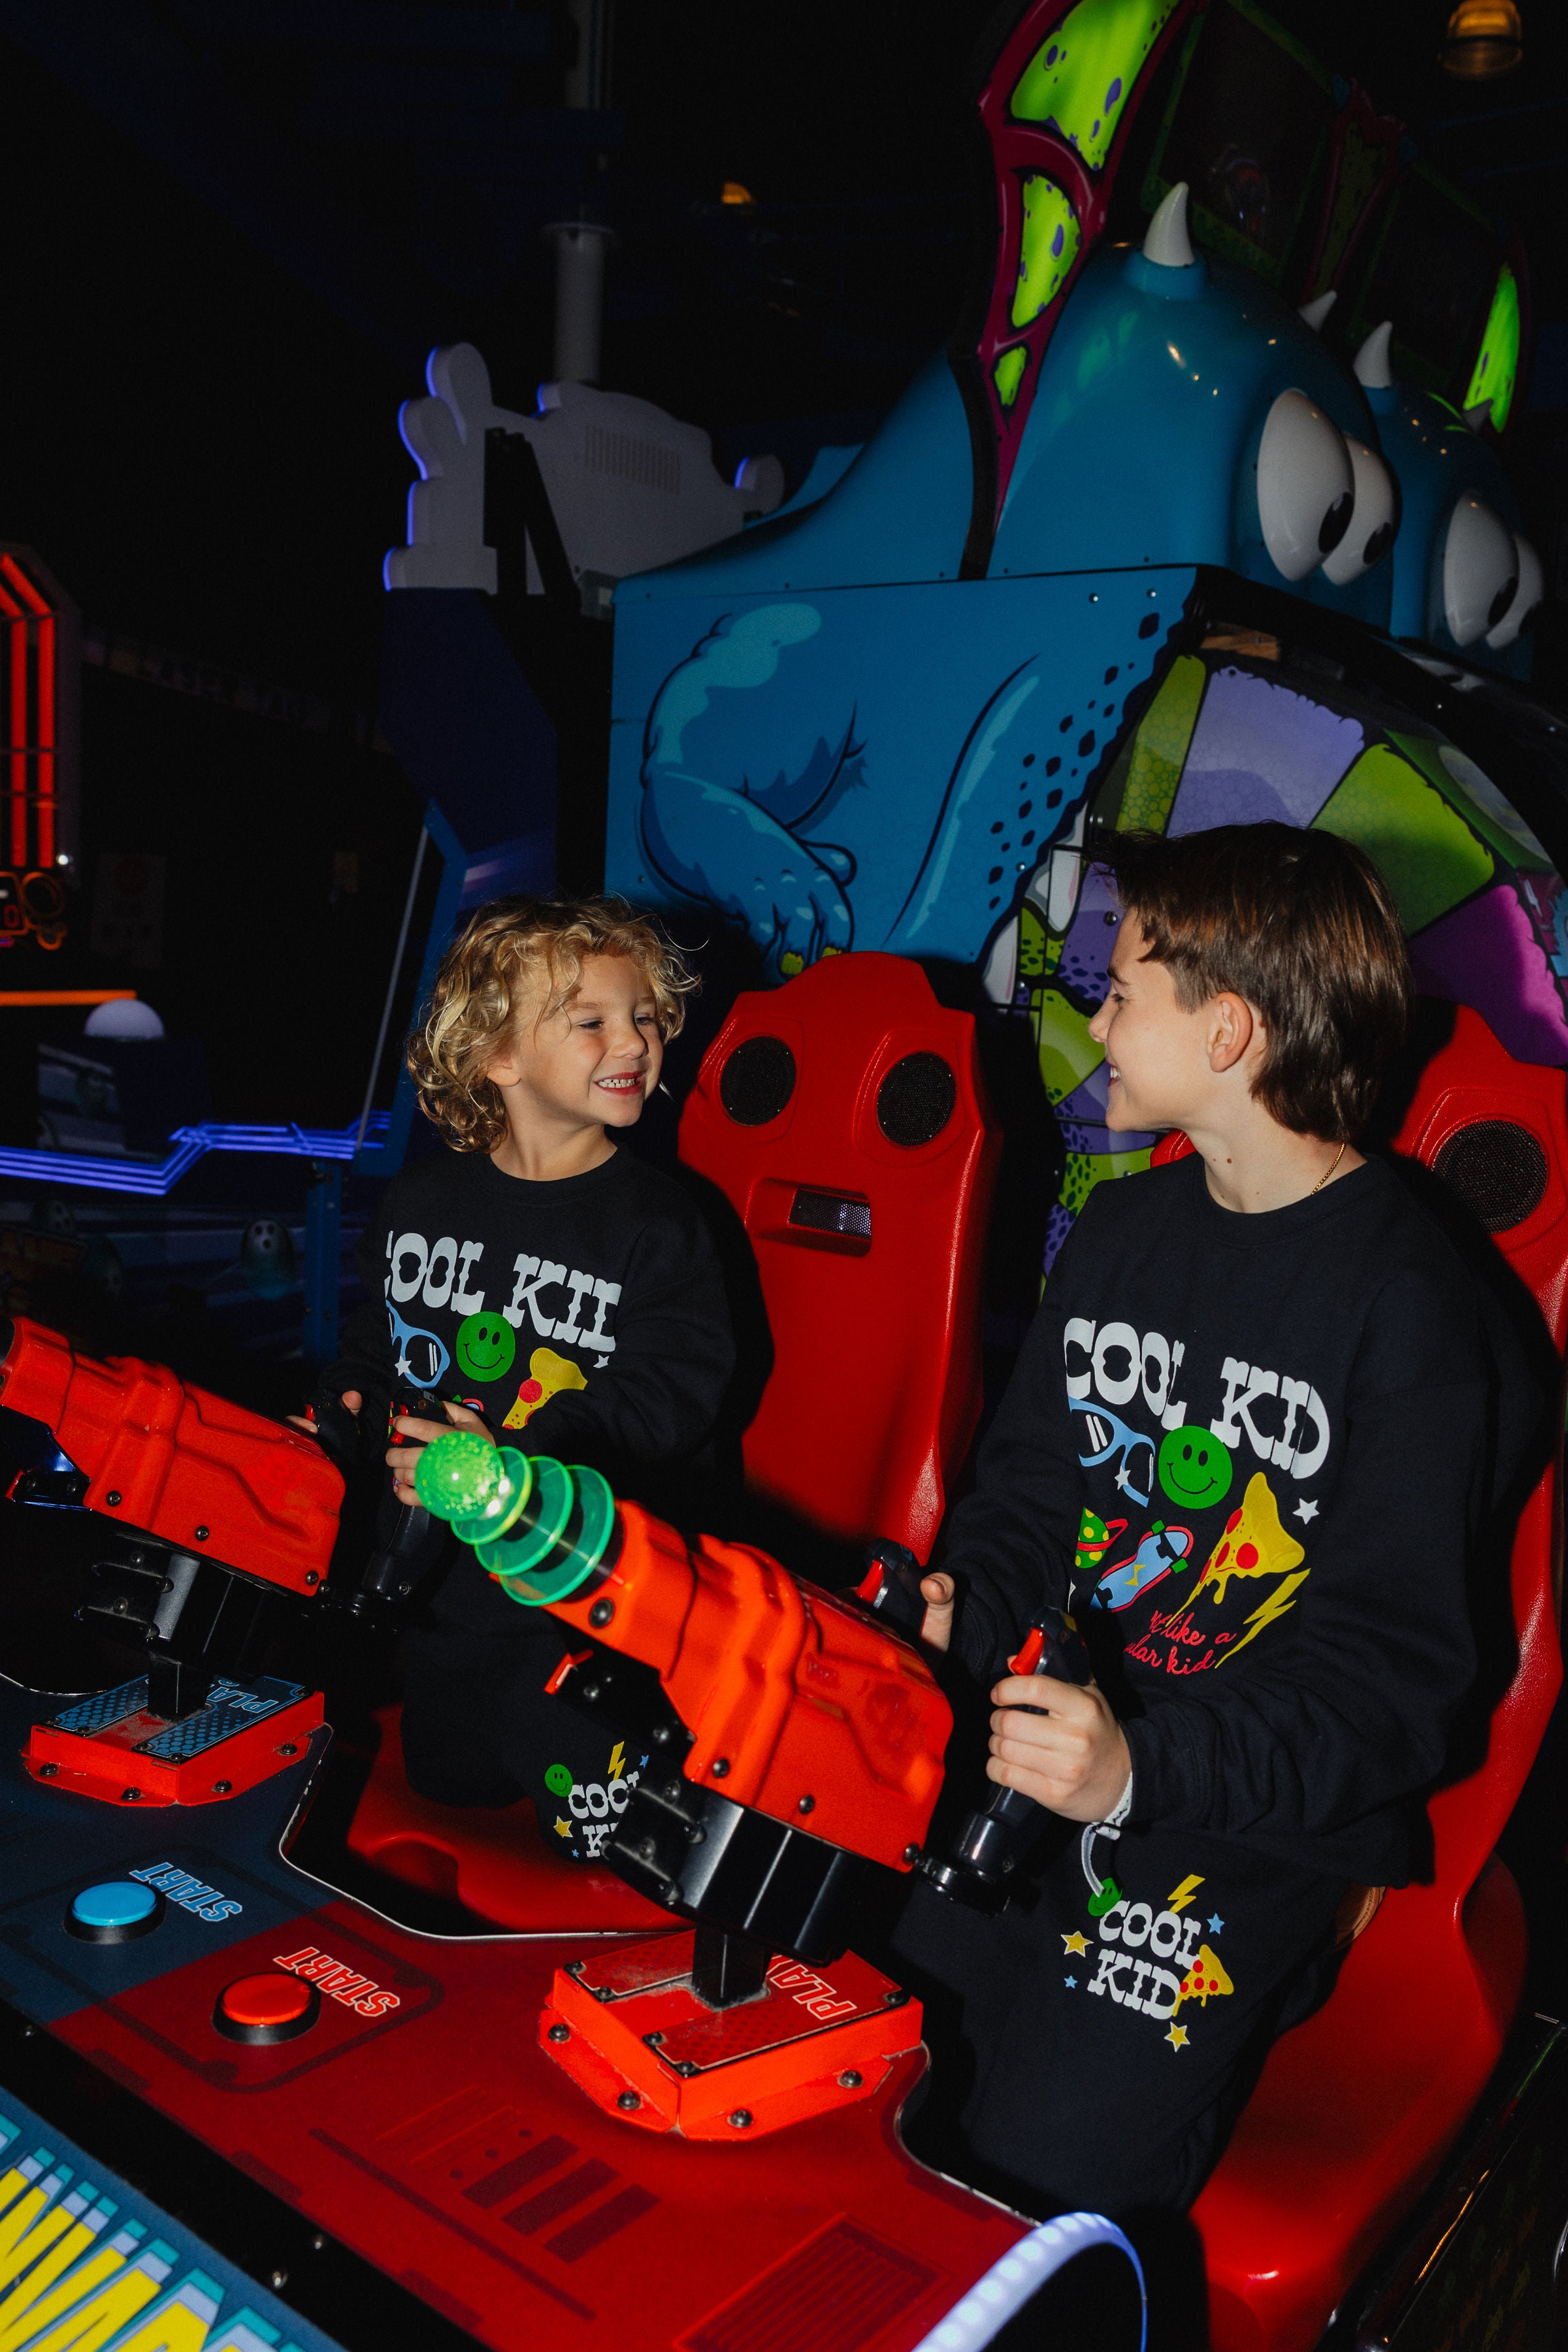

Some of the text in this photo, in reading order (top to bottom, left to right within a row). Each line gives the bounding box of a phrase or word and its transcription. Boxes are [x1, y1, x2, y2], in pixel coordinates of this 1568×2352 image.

[384, 1230, 485, 1316] OOL
[1064, 1318, 1330, 1479] COOL KID
[1166, 1646, 1216, 1675] kid
[1214, 1632, 1237, 1644] a
[568, 1771, 640, 1819] COO
[129, 1862, 242, 1922] START
[1099, 1900, 1201, 1970] COOL
[272, 1946, 400, 2017] START
[1087, 1949, 1181, 2019] KID
